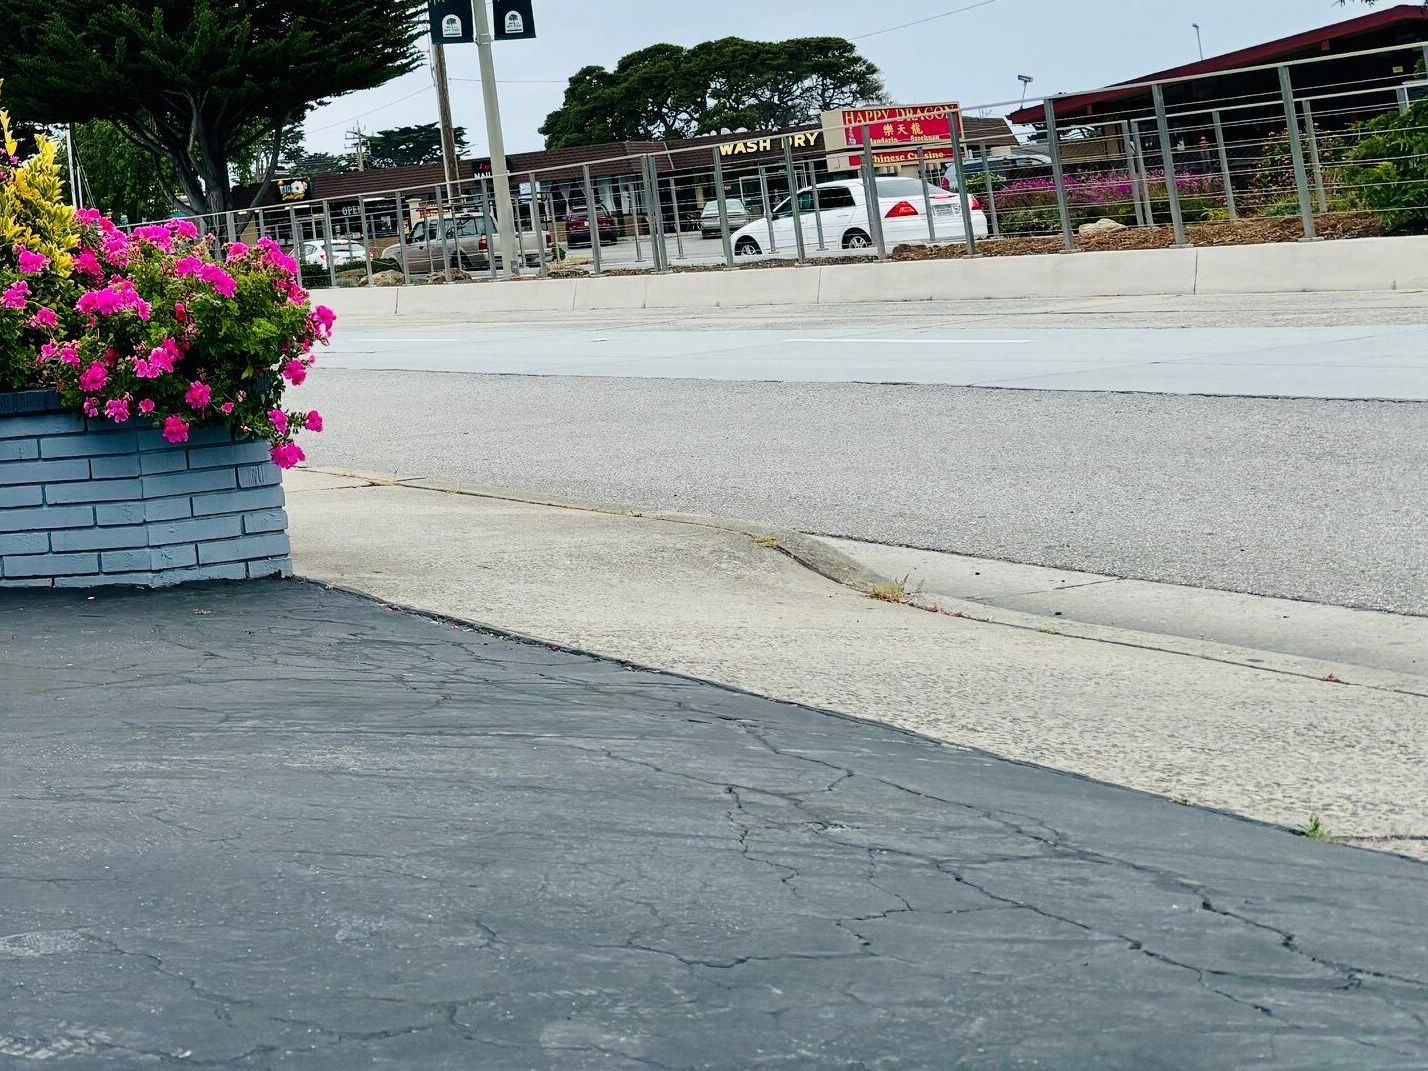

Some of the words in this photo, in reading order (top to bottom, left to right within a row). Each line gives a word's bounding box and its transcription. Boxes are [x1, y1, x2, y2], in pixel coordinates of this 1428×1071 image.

[844, 109, 890, 125] HAPPY
[719, 138, 771, 156] WASH
[869, 136, 899, 144] andarin
[872, 152, 905, 164] hinese
